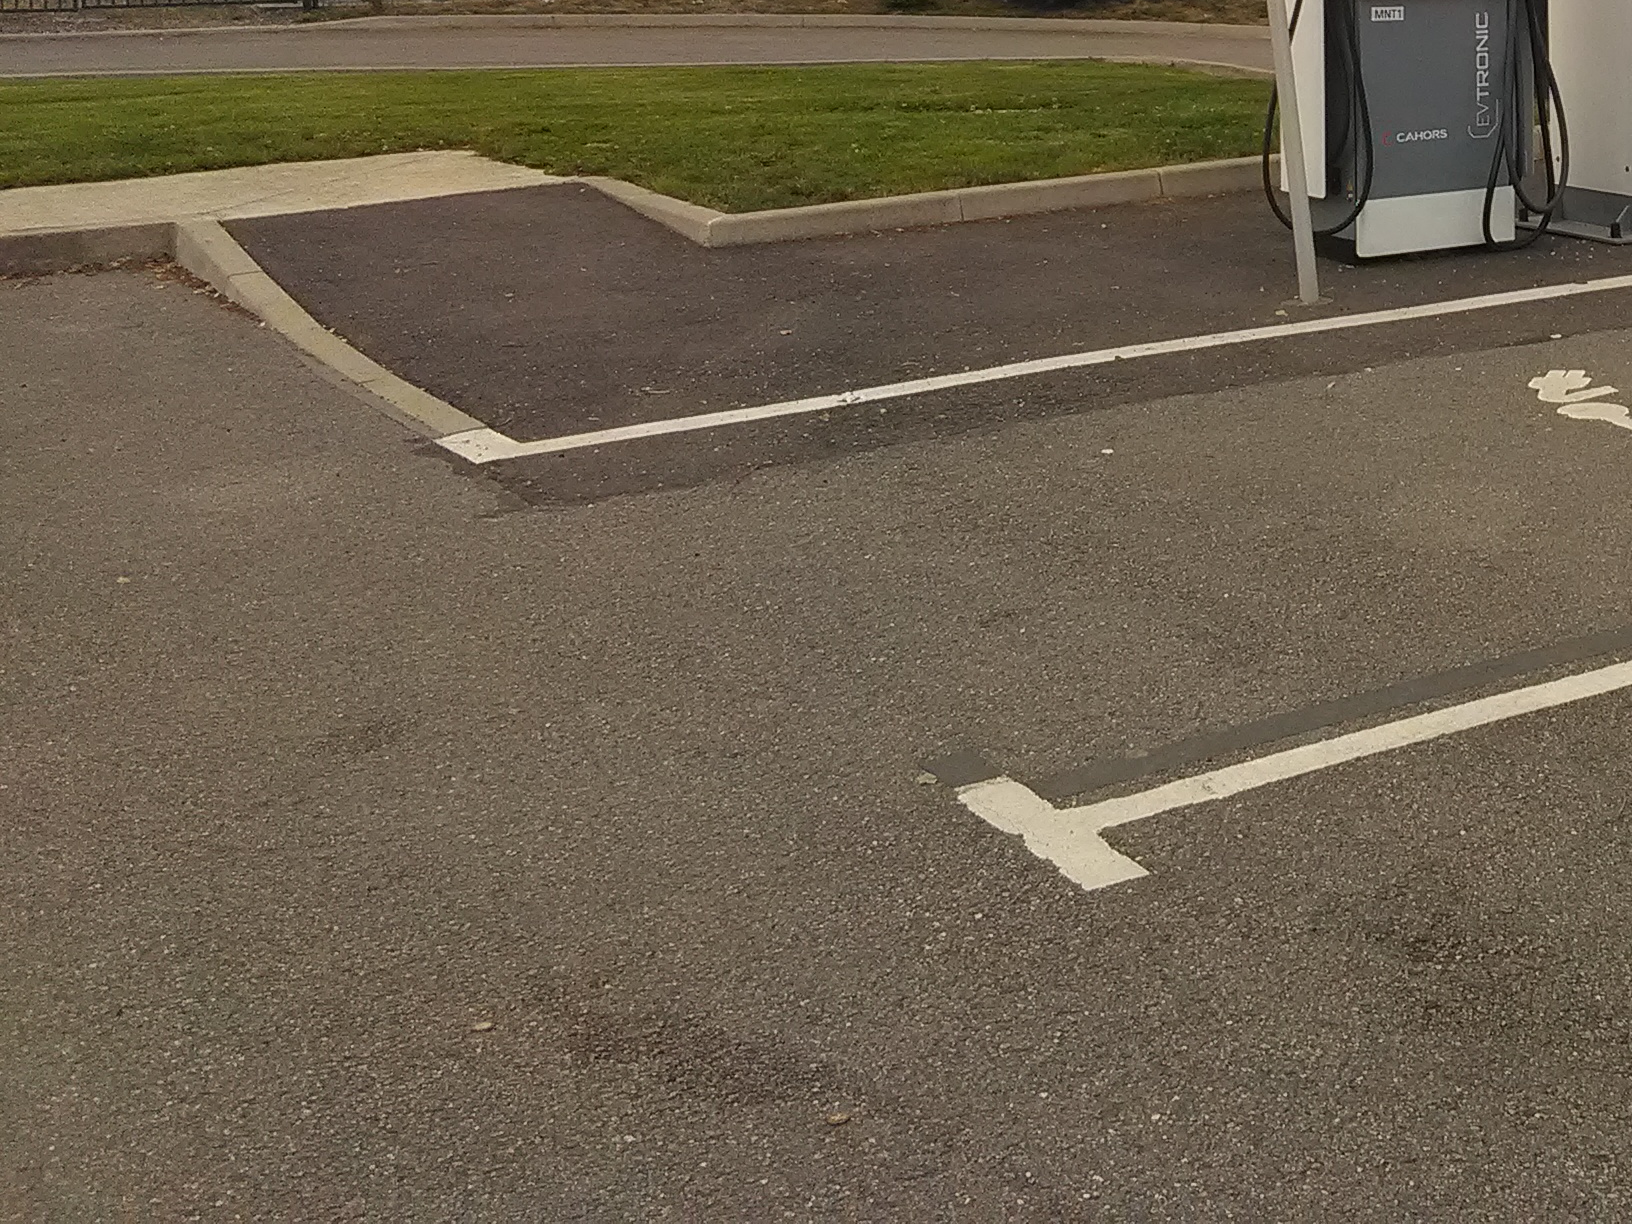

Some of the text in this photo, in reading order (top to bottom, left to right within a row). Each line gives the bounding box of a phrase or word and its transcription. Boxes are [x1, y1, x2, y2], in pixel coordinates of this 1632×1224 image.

[1374, 9, 1402, 19] MNT1
[1475, 11, 1490, 127] EVTRONIC
[1396, 128, 1448, 143] CAHORS
